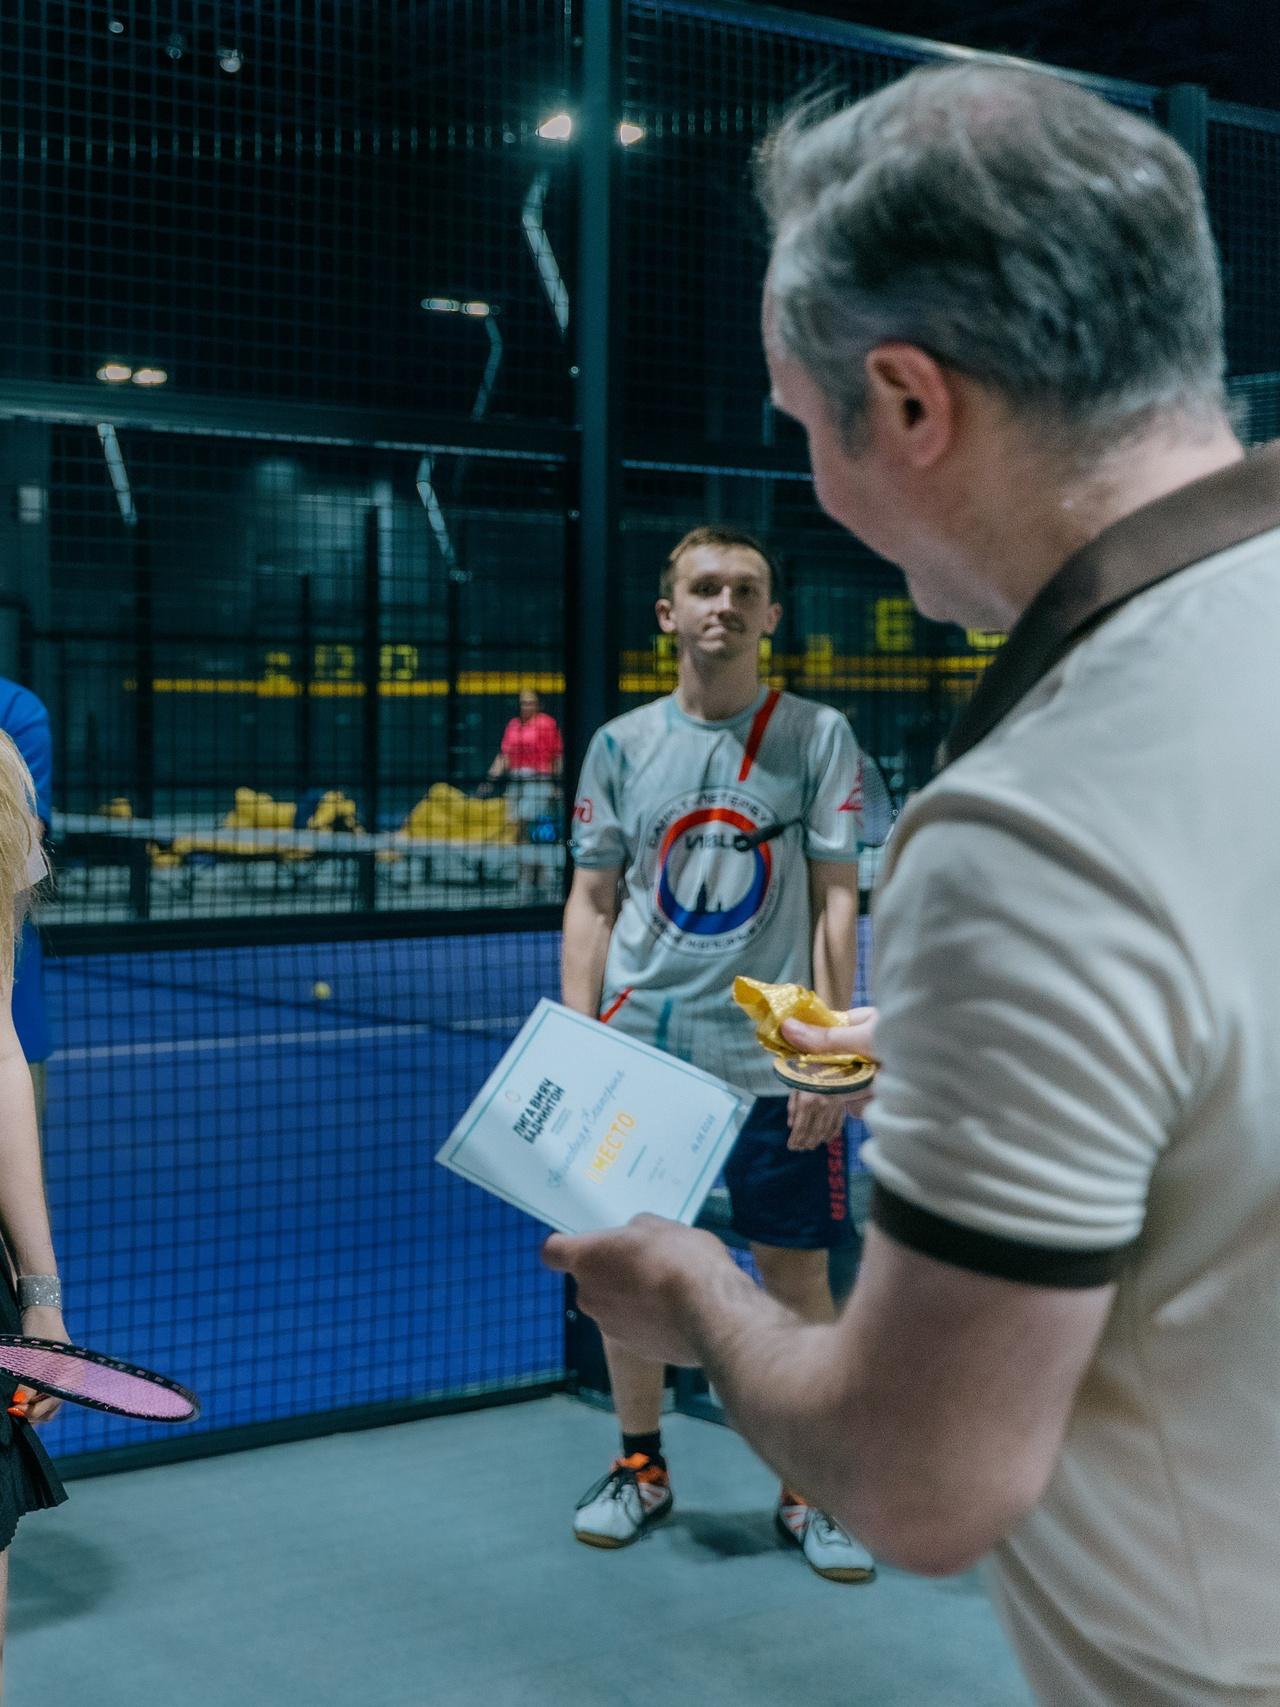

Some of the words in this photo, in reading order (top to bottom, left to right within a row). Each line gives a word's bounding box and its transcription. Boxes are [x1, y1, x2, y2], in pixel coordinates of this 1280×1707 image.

[512, 1108, 535, 1136] ЛИГА
[529, 1078, 554, 1109] ВМЯЧ
[522, 1085, 564, 1143] БАДМИНТОН
[590, 1111, 636, 1175] МЕСТО
